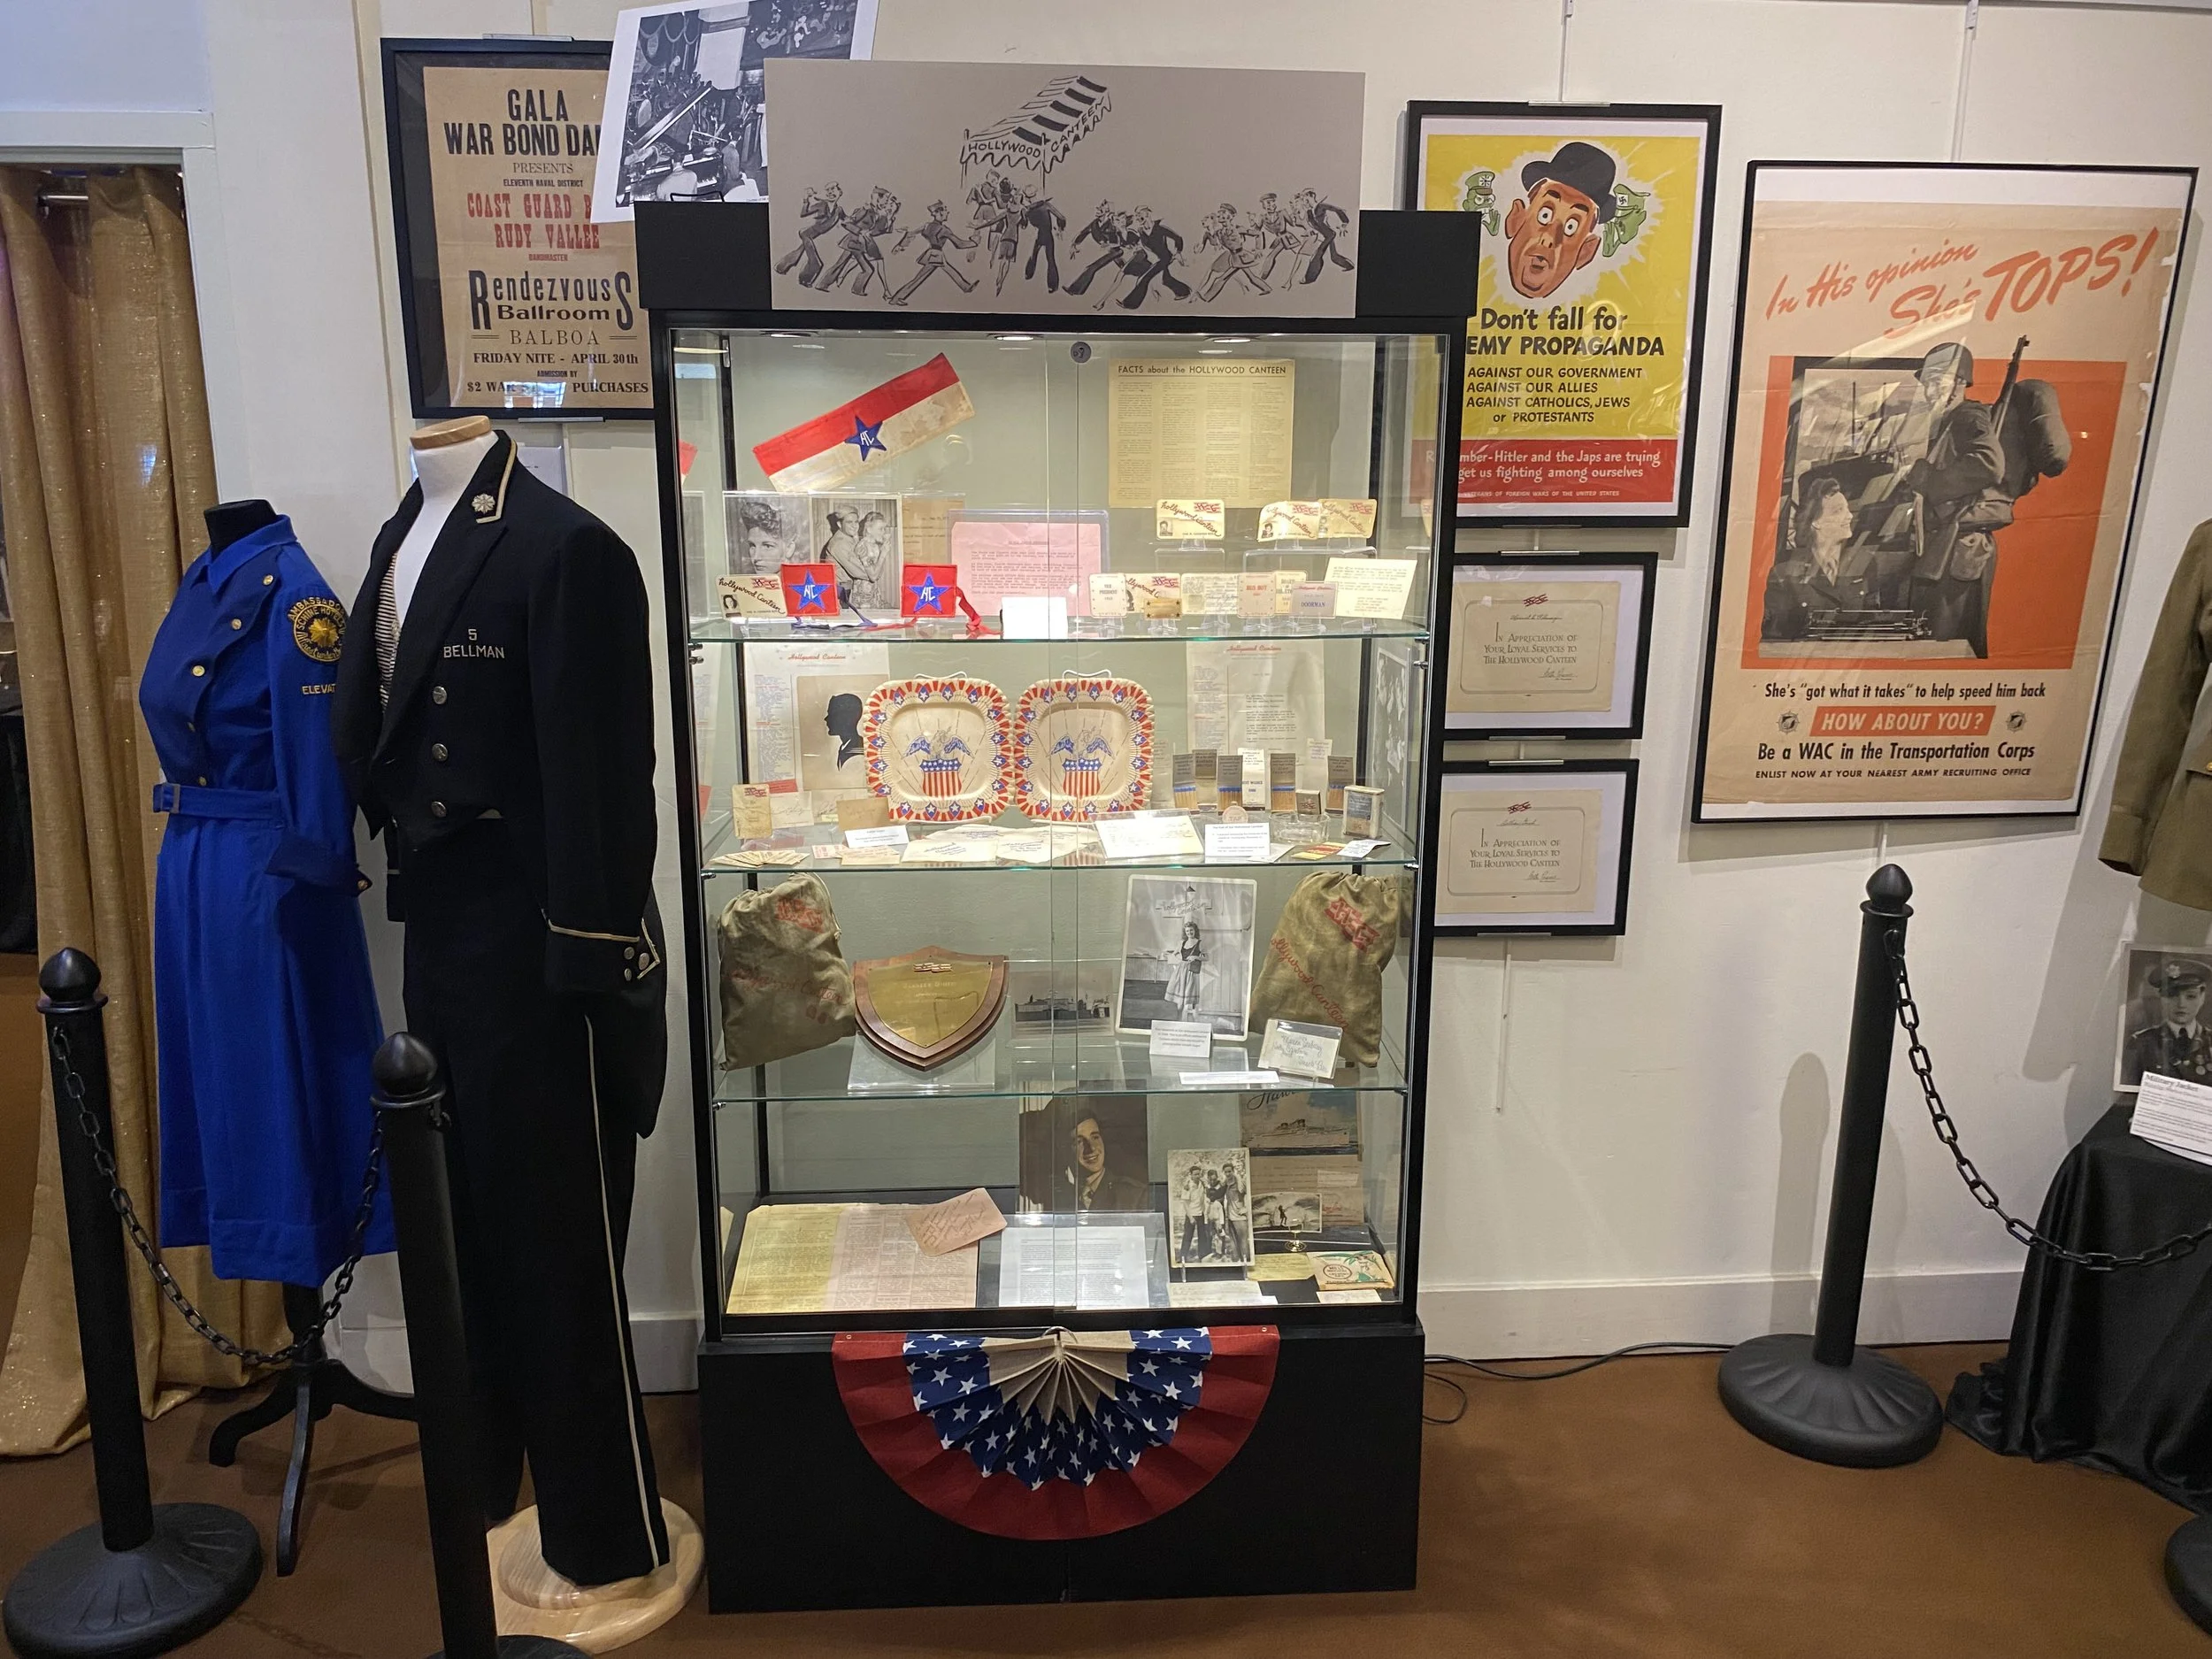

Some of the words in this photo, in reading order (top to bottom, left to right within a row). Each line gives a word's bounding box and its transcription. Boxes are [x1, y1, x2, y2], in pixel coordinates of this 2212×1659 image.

[508, 89, 568, 121] GALA
[1050, 96, 1104, 152] CANTEEN
[444, 123, 494, 155] WAR
[503, 124, 560, 156] BOND
[969, 140, 1041, 157] HOLLYWOOD
[513, 162, 573, 174] PRESENTS
[467, 193, 511, 219] COAST
[524, 194, 571, 219] GUARD
[495, 224, 532, 249] RUDY
[546, 224, 600, 250] VALLEE
[1766, 274, 1800, 320] In
[1806, 262, 1856, 309] His
[1865, 239, 1979, 305] opinion
[1884, 279, 1982, 340] She's
[1983, 227, 2160, 322] TOPS!
[498, 305, 610, 319] Ballroom
[1481, 307, 1538, 330] Don't
[1548, 306, 1583, 330] fall
[1594, 307, 1628, 330] for
[511, 330, 600, 345] BALBOA
[1466, 335, 1512, 355] EMY
[1520, 336, 1664, 356] PROPAGANDA
[473, 353, 521, 365] FRIDAY
[526, 353, 556, 365] NITE
[571, 353, 610, 365] APRIL
[613, 353, 639, 365] 30th
[1148, 365, 1169, 374] about
[1468, 367, 1522, 378] AGAINST
[1526, 367, 1554, 378] OUR
[1558, 367, 1642, 378] GOVERNMENT
[467, 382, 481, 392] $2
[573, 382, 649, 394] PURCHASES
[1466, 382, 1521, 393] AGAINST
[1526, 382, 1554, 393] OUR
[1558, 382, 1598, 393] ALLIES
[1466, 397, 1519, 408] AGAINST
[1525, 397, 1593, 409] CATHOLICS,
[1595, 397, 1631, 408] JEWS
[1494, 413, 1506, 422] or
[1513, 412, 1594, 423] PROTESTANTS
[1532, 450, 1551, 462] and
[1556, 449, 1574, 463] the
[1577, 450, 1601, 465] Japs
[1604, 453, 1621, 463] are
[1626, 451, 1661, 467] trying
[1458, 468, 1476, 483] get
[1479, 468, 1492, 477] us
[1496, 465, 1542, 483] fighting
[1548, 468, 1587, 483] among
[1592, 465, 1643, 477] ourselves
[718, 578, 757, 597] hollywood
[757, 594, 786, 614] Canteen
[803, 584, 818, 599] HC
[920, 586, 935, 602] HC
[468, 629, 478, 641] 5
[443, 645, 505, 658] BELLMAN
[1765, 683, 1796, 698] She's
[1830, 684, 1858, 698] what
[1863, 684, 1871, 698] it
[1916, 686, 1926, 697] to
[1931, 683, 1953, 700] help
[1959, 684, 1992, 700] speed
[1996, 684, 2016, 697] him
[2021, 683, 2046, 697] back
[1821, 714, 1863, 731] HOW
[1871, 713, 1930, 731] ABOUT
[1938, 712, 1985, 731] YOU?
[1758, 742, 1775, 760] Be
[1782, 747, 1792, 760] a
[1799, 742, 1834, 760] WAC
[1840, 742, 1854, 760] in
[1861, 742, 1883, 760] the
[1890, 742, 1990, 764] Transportation
[1997, 742, 2035, 762] Corps
[1755, 770, 1786, 779] ENLIST
[1791, 770, 1816, 779] NOW
[1820, 770, 1832, 779] AT
[1868, 769, 1907, 778] NEAREST
[1911, 769, 1939, 778] ARMY
[1943, 768, 1997, 778] RECRUITING
[1271, 935, 1313, 986] ollywood
